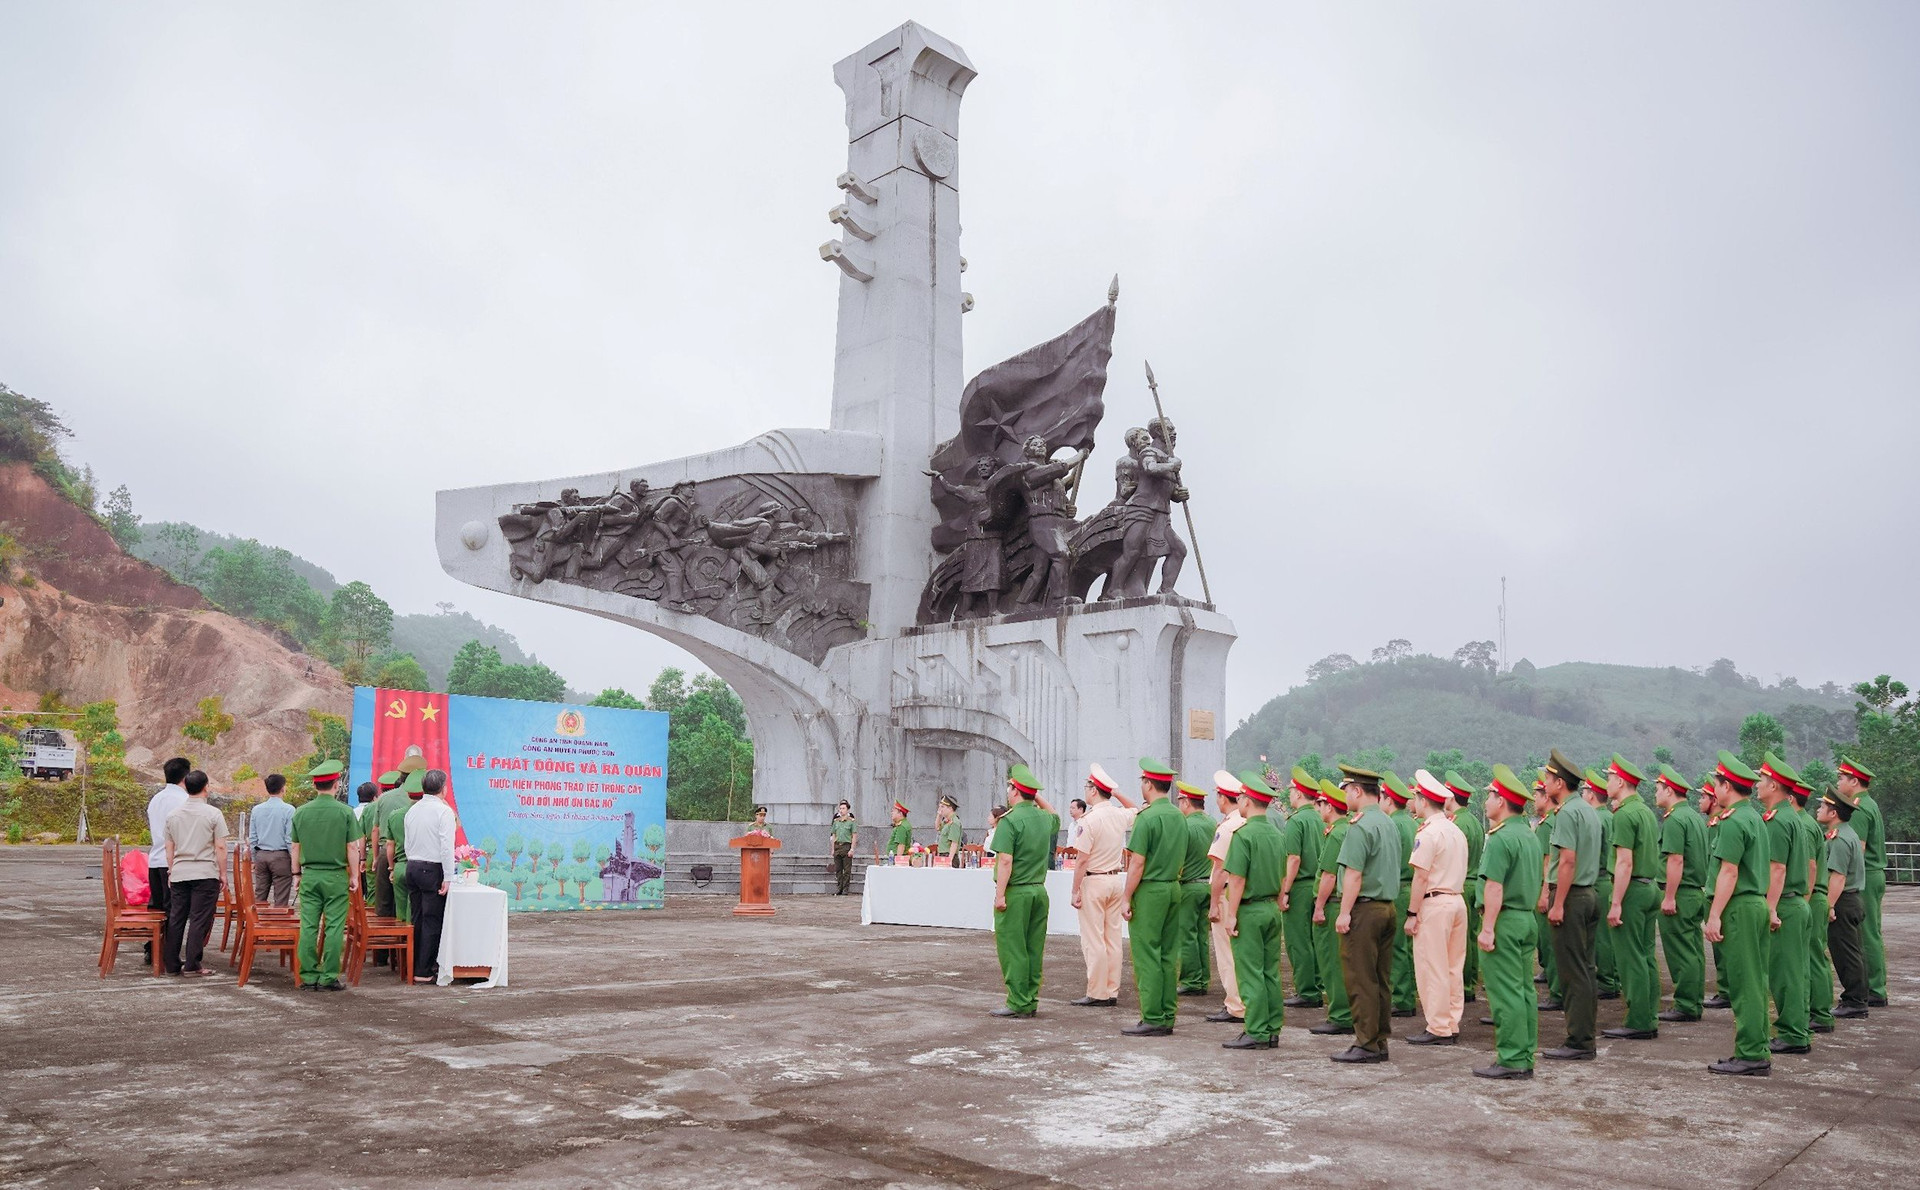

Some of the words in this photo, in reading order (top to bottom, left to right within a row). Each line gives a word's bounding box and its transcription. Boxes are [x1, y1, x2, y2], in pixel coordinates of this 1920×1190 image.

[467, 752, 486, 769] LỄ
[490, 756, 530, 771] PHÁT
[534, 758, 575, 775] ĐỘNG
[579, 760, 598, 774] VÀ
[601, 763, 620, 776] RA
[624, 764, 662, 778] QUÂN
